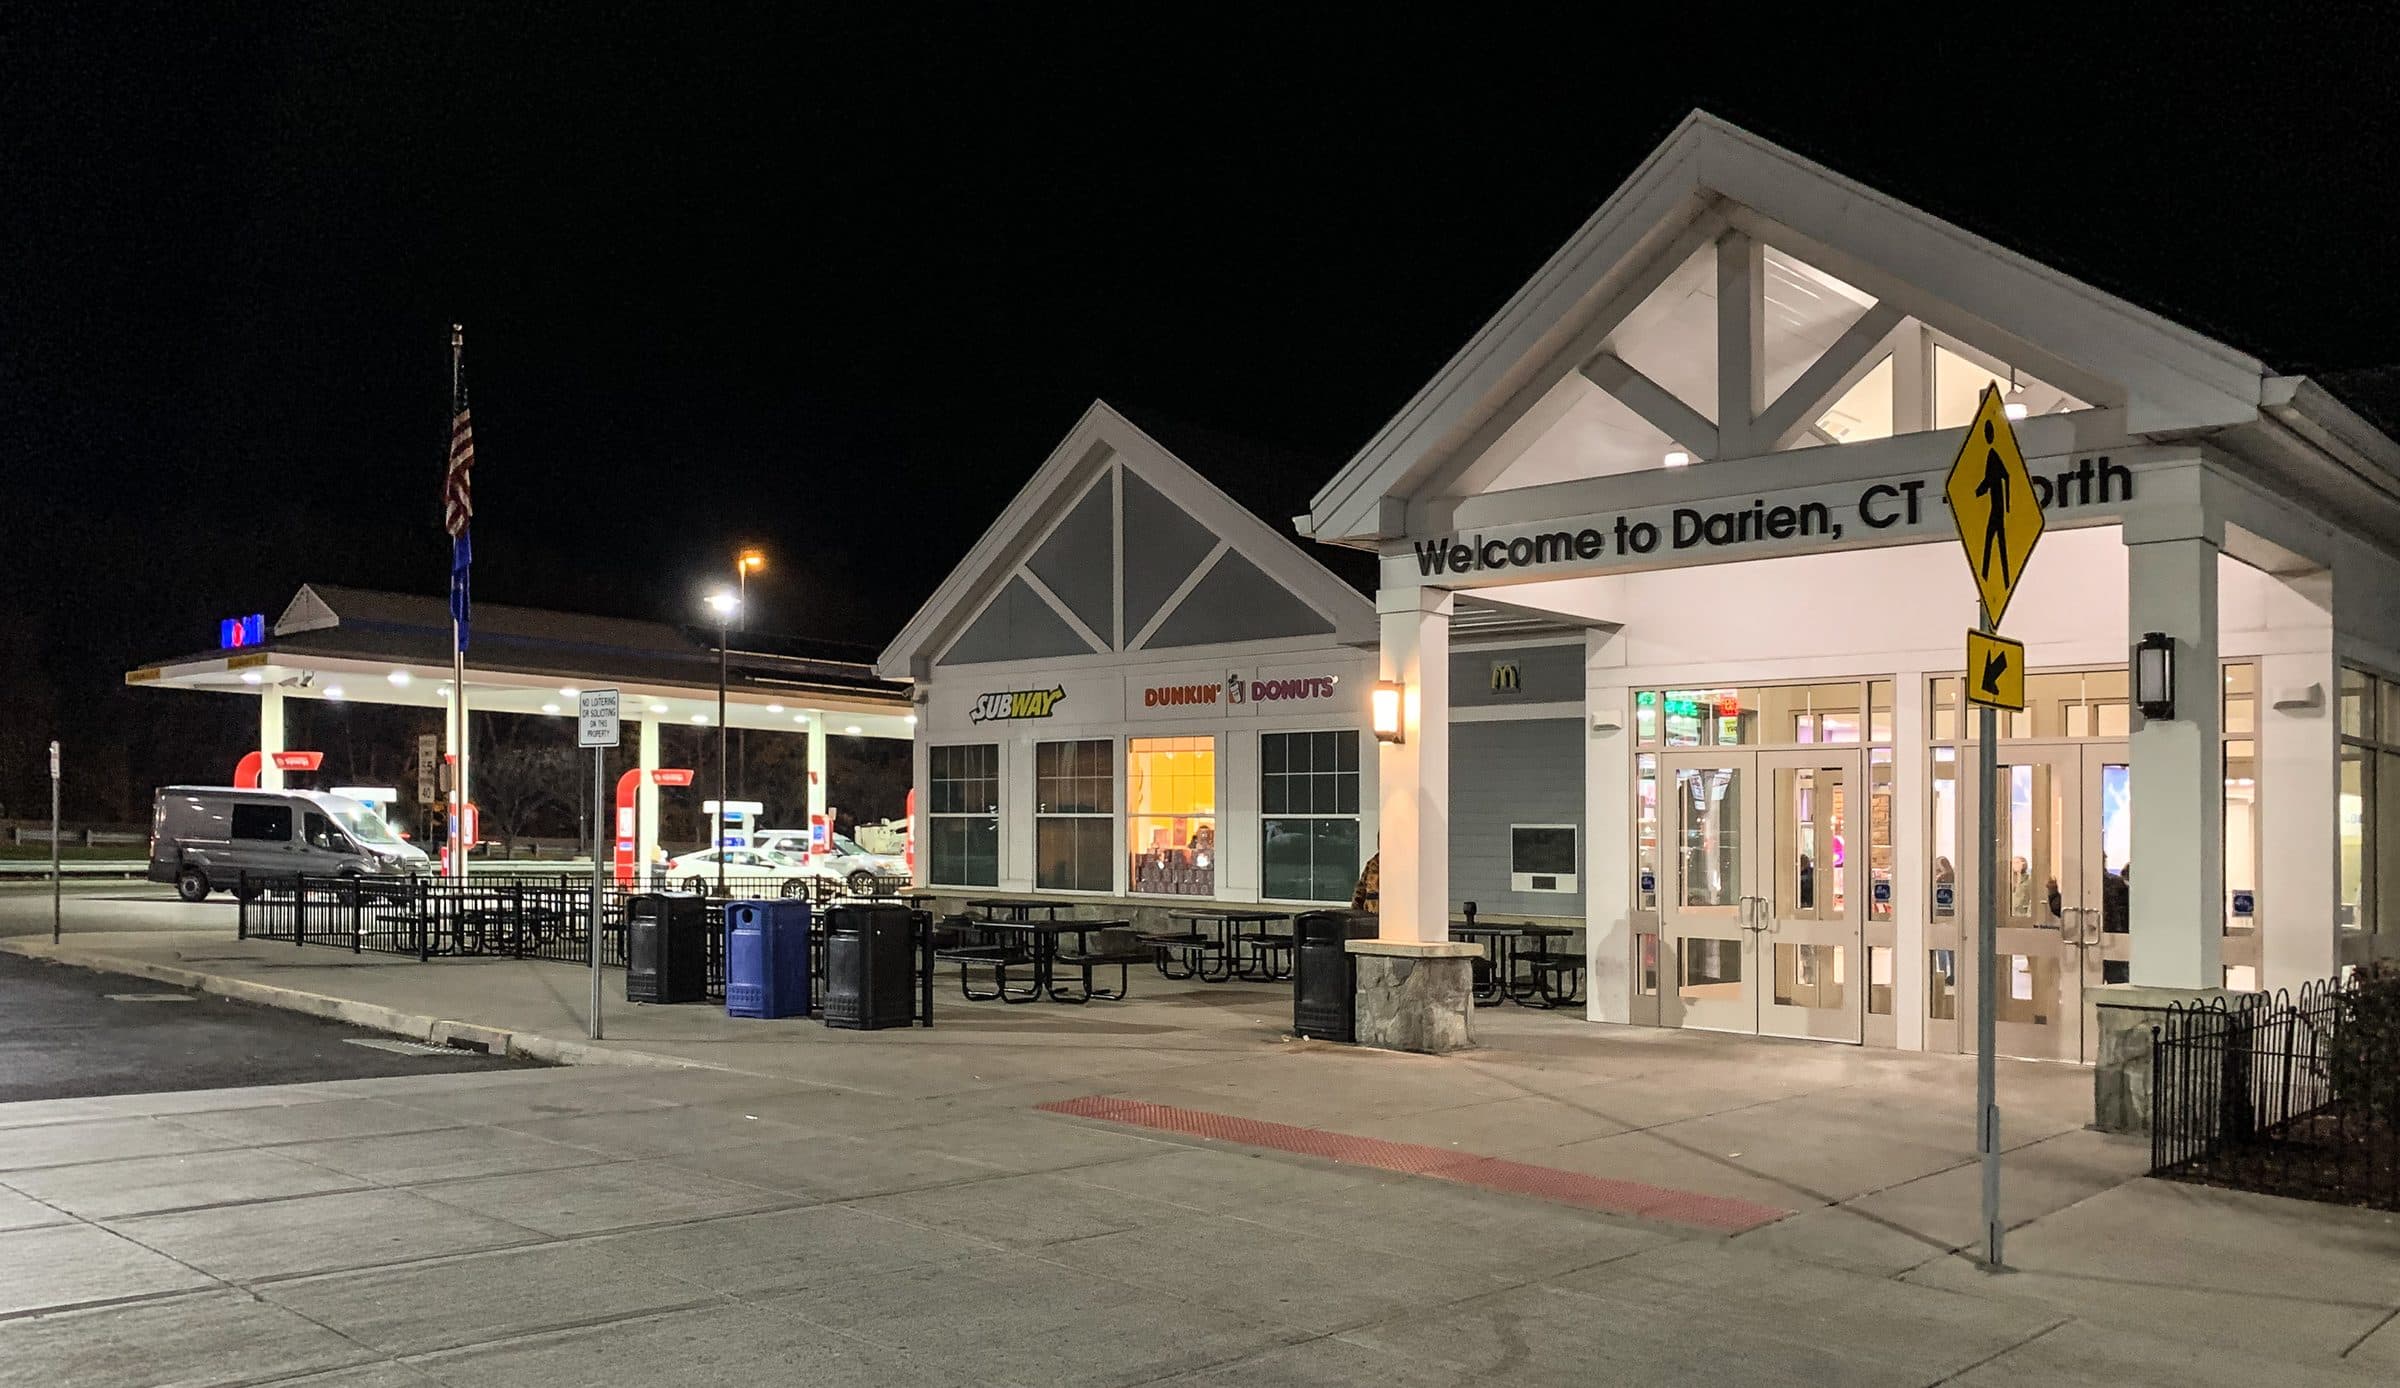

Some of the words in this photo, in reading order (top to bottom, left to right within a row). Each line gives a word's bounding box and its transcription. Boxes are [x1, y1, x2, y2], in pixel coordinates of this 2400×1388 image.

[1414, 529, 1602, 576] Welcome
[1614, 516, 1658, 555] to
[1673, 500, 1842, 549] Darien,
[1859, 480, 1925, 529] CT
[2031, 456, 2132, 510] orth
[583, 698, 590, 706] NO
[591, 697, 616, 706] LOITERING
[970, 684, 1066, 724] SUBWAY
[1144, 683, 1222, 707] DUNKIN'
[1251, 675, 1335, 702] DONUTS
[582, 709, 590, 718] OR
